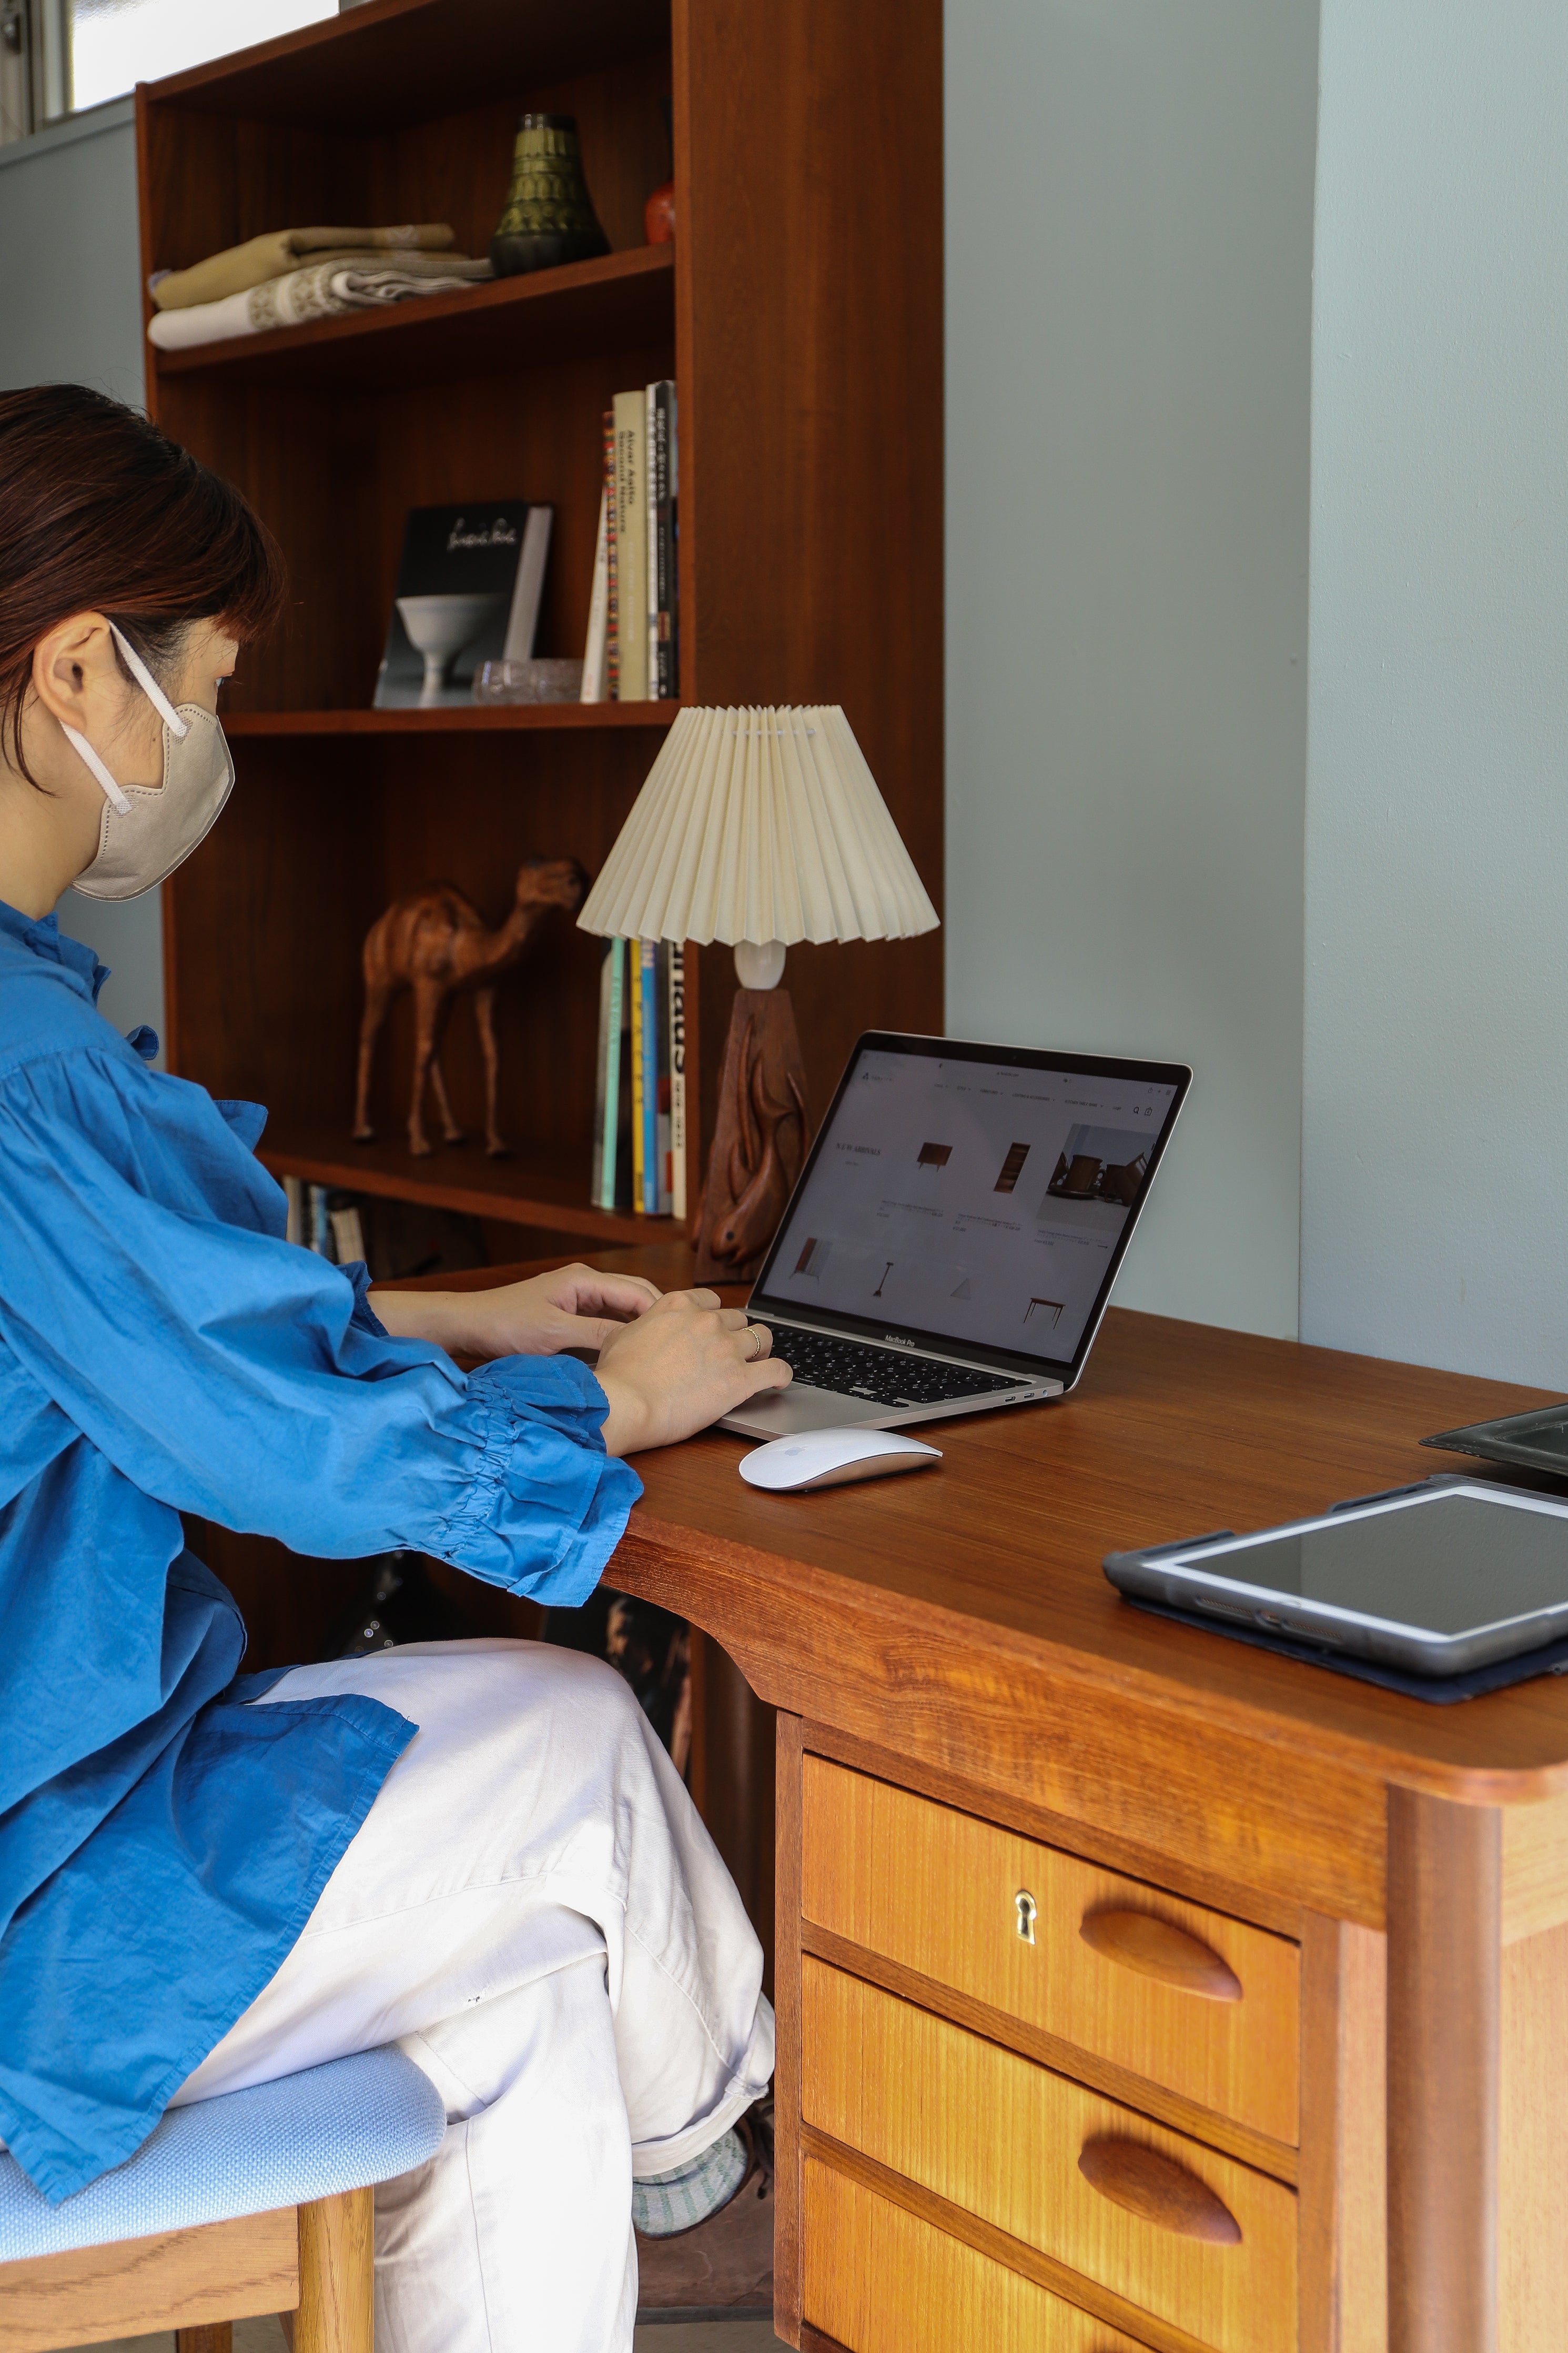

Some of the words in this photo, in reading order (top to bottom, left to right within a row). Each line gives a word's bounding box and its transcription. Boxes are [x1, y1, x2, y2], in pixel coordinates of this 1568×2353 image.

[619, 431, 627, 482] Second
[627, 430, 636, 465] Alvar
[628, 469, 636, 505] Aalto
[835, 1142, 853, 1151] NEW
[853, 1145, 882, 1155] ARRIVALS
[885, 1334, 907, 1345] MacBook
